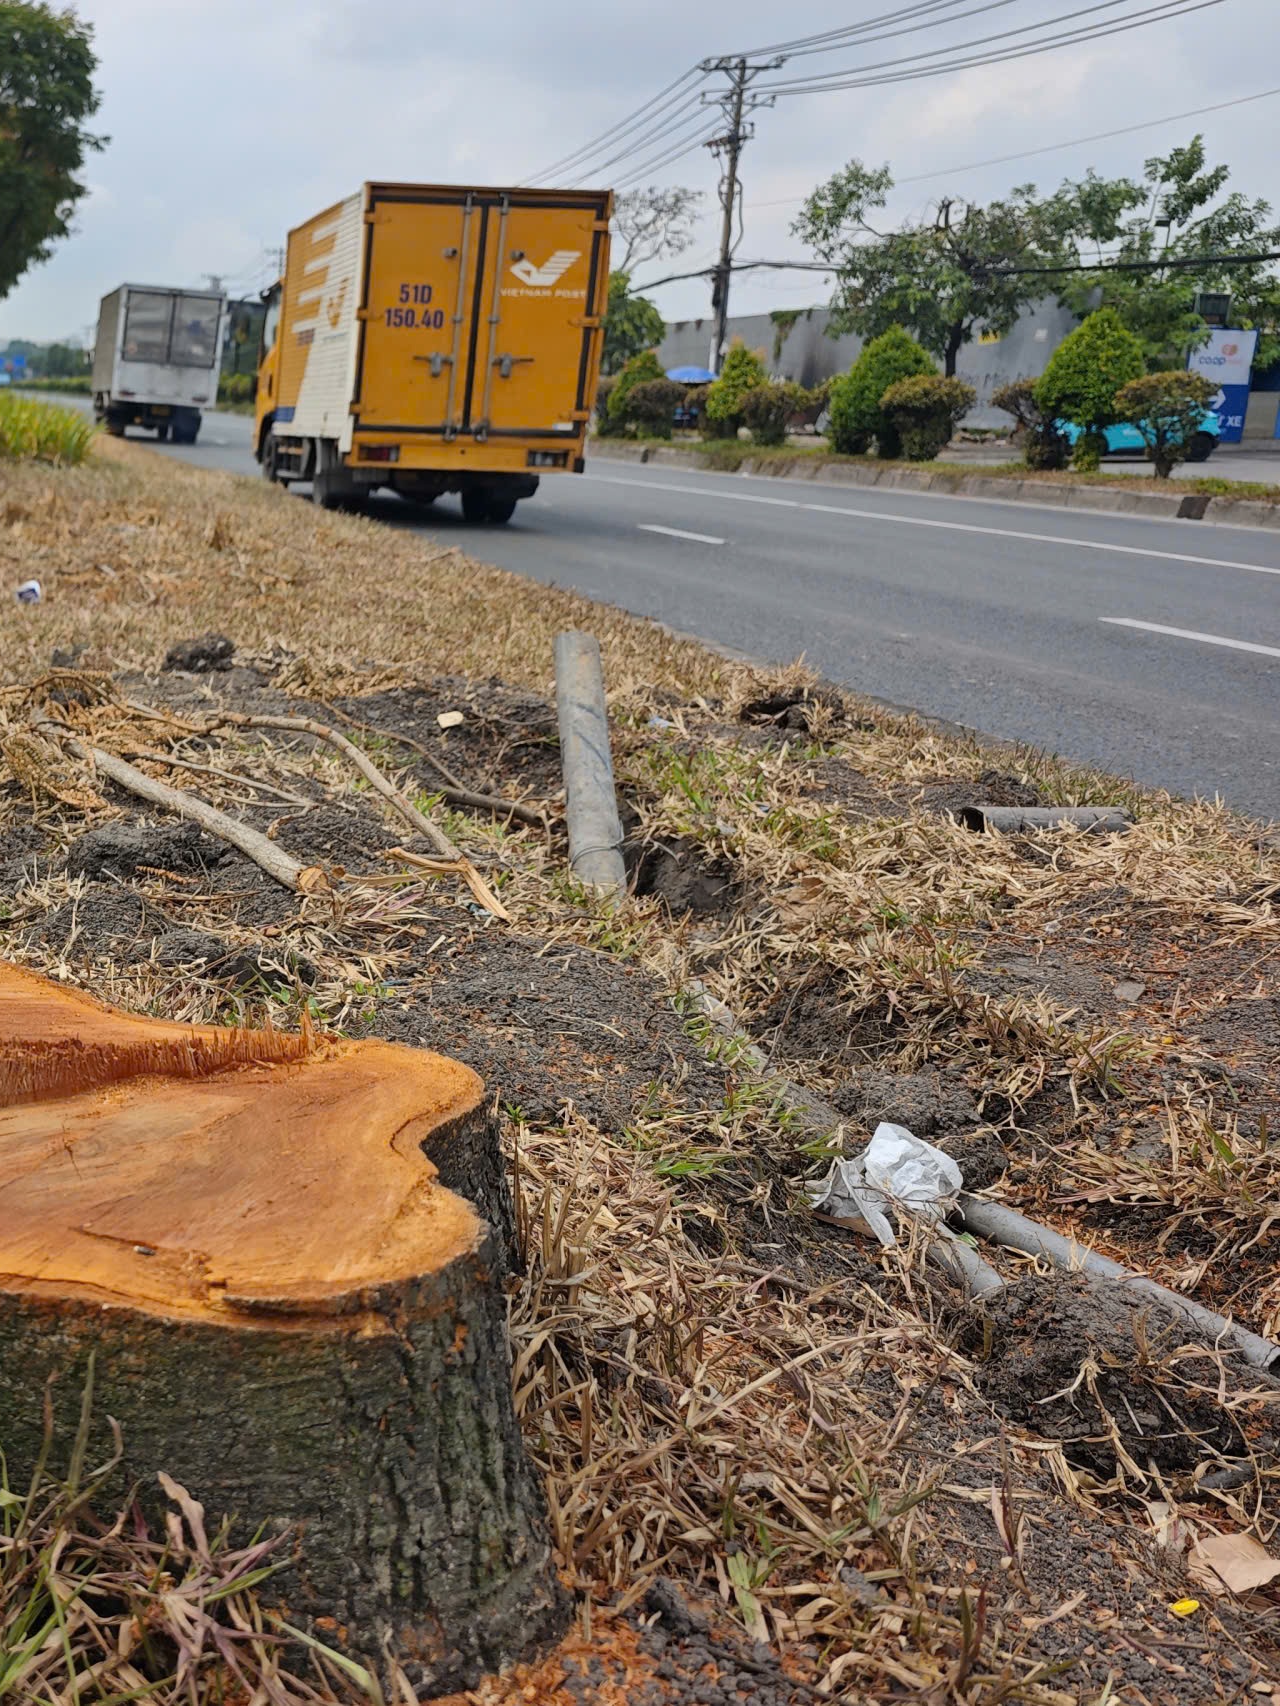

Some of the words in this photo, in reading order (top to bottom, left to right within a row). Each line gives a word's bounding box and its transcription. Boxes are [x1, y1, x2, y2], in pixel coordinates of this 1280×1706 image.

[400, 284, 432, 304] 51D
[500, 288, 551, 297] VIETNAM
[385, 308, 444, 329] 150.40
